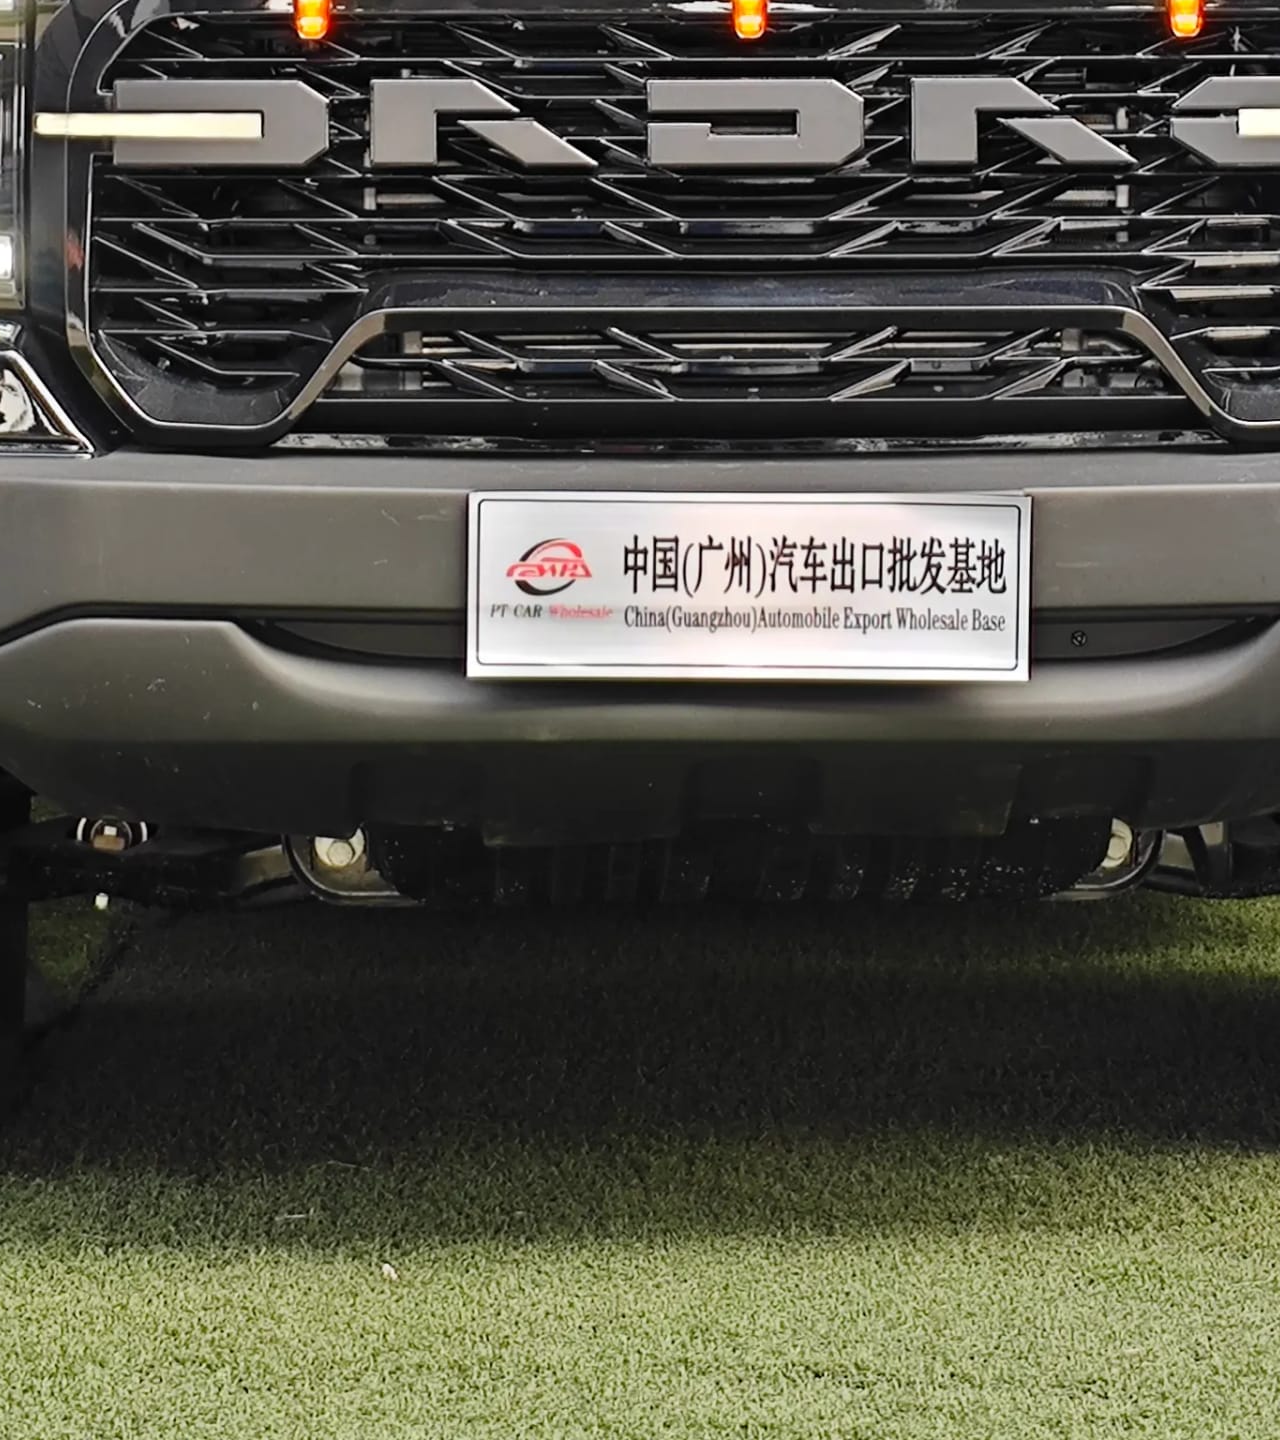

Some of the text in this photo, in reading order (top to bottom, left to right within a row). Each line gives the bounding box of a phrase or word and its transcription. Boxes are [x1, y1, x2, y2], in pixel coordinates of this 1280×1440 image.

[623, 534, 1008, 599] 中国(广州)汽车出口批发基地
[513, 603, 544, 619] CAR
[843, 606, 892, 635] Export
[896, 606, 969, 632] Wholesale
[972, 608, 1007, 632] Base
